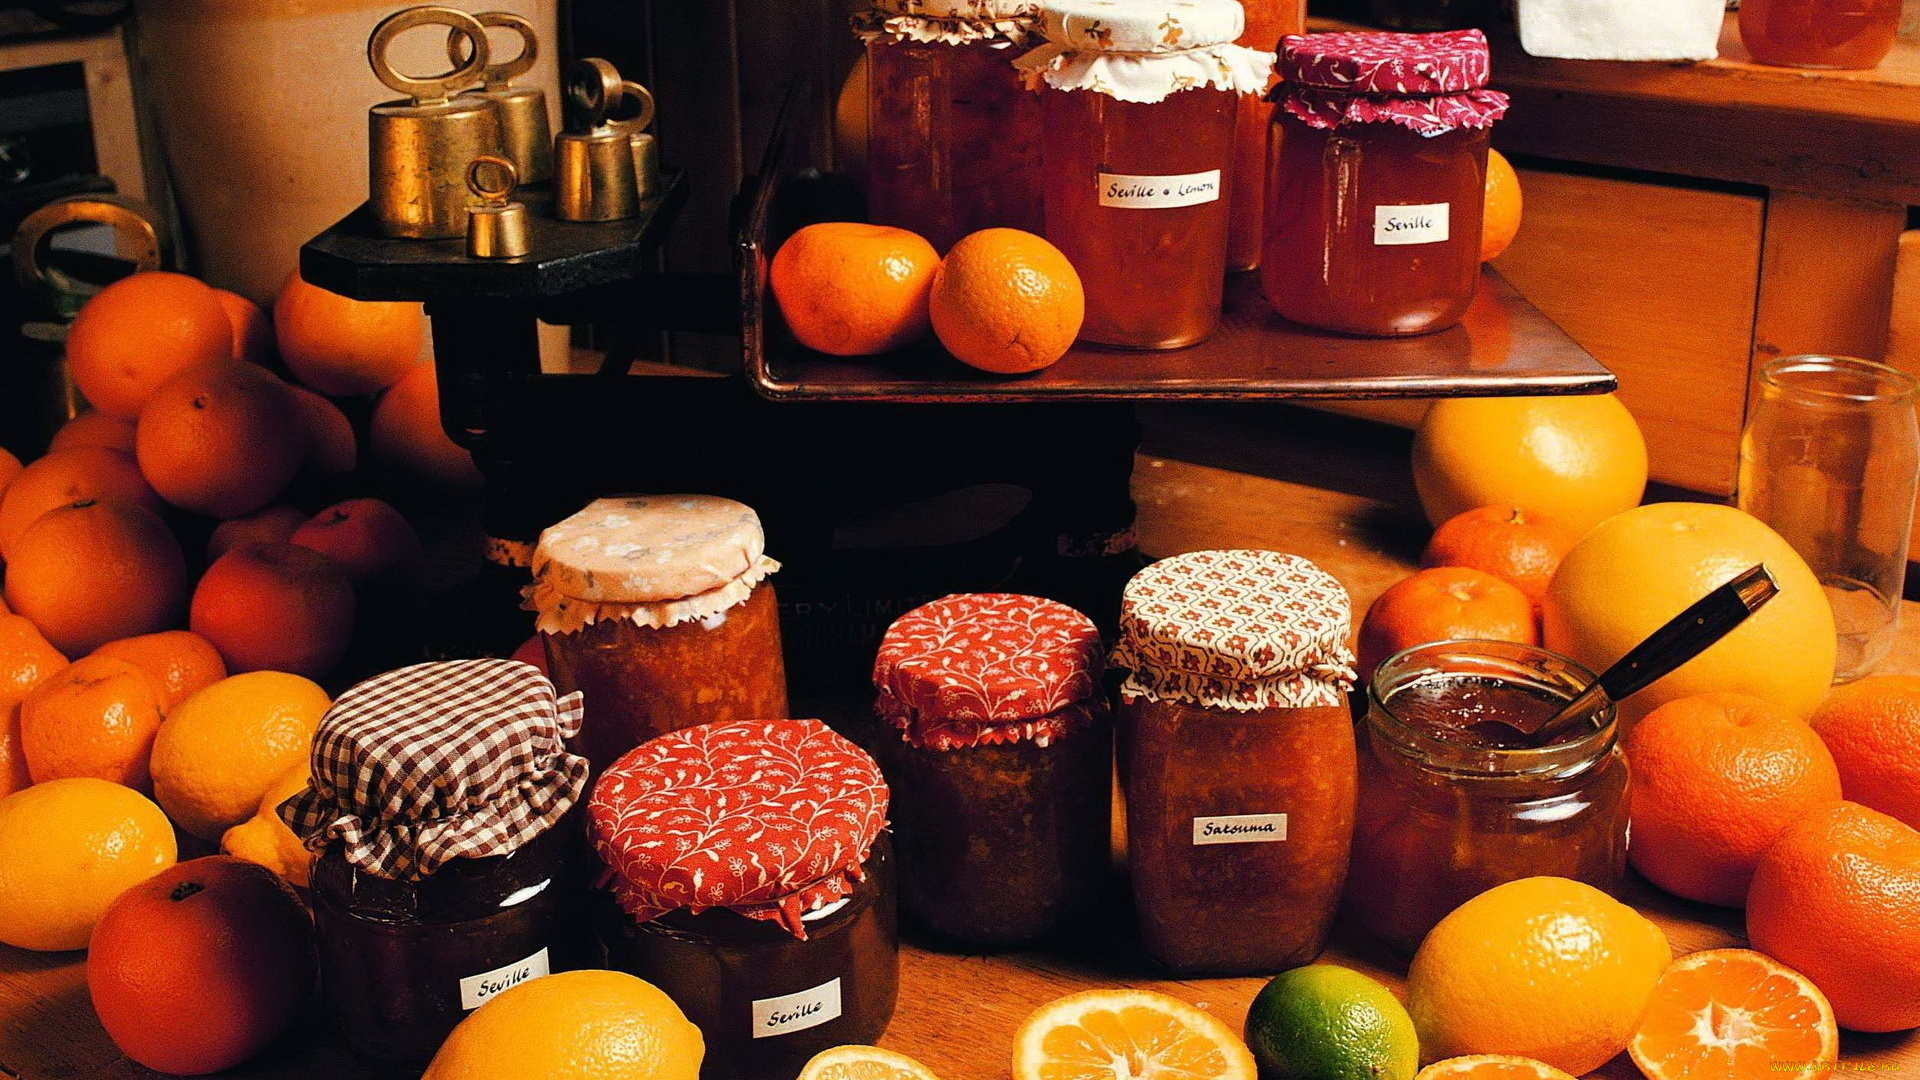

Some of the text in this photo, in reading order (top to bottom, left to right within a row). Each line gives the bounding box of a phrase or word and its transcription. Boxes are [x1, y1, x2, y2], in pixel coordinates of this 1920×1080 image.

[1106, 183, 1156, 199] Seville
[1178, 183, 1215, 197] Lemon
[1384, 215, 1434, 232] Seville
[1203, 822, 1277, 837] Satsuma
[477, 966, 531, 997] Seville
[766, 1001, 824, 1027] Seville
